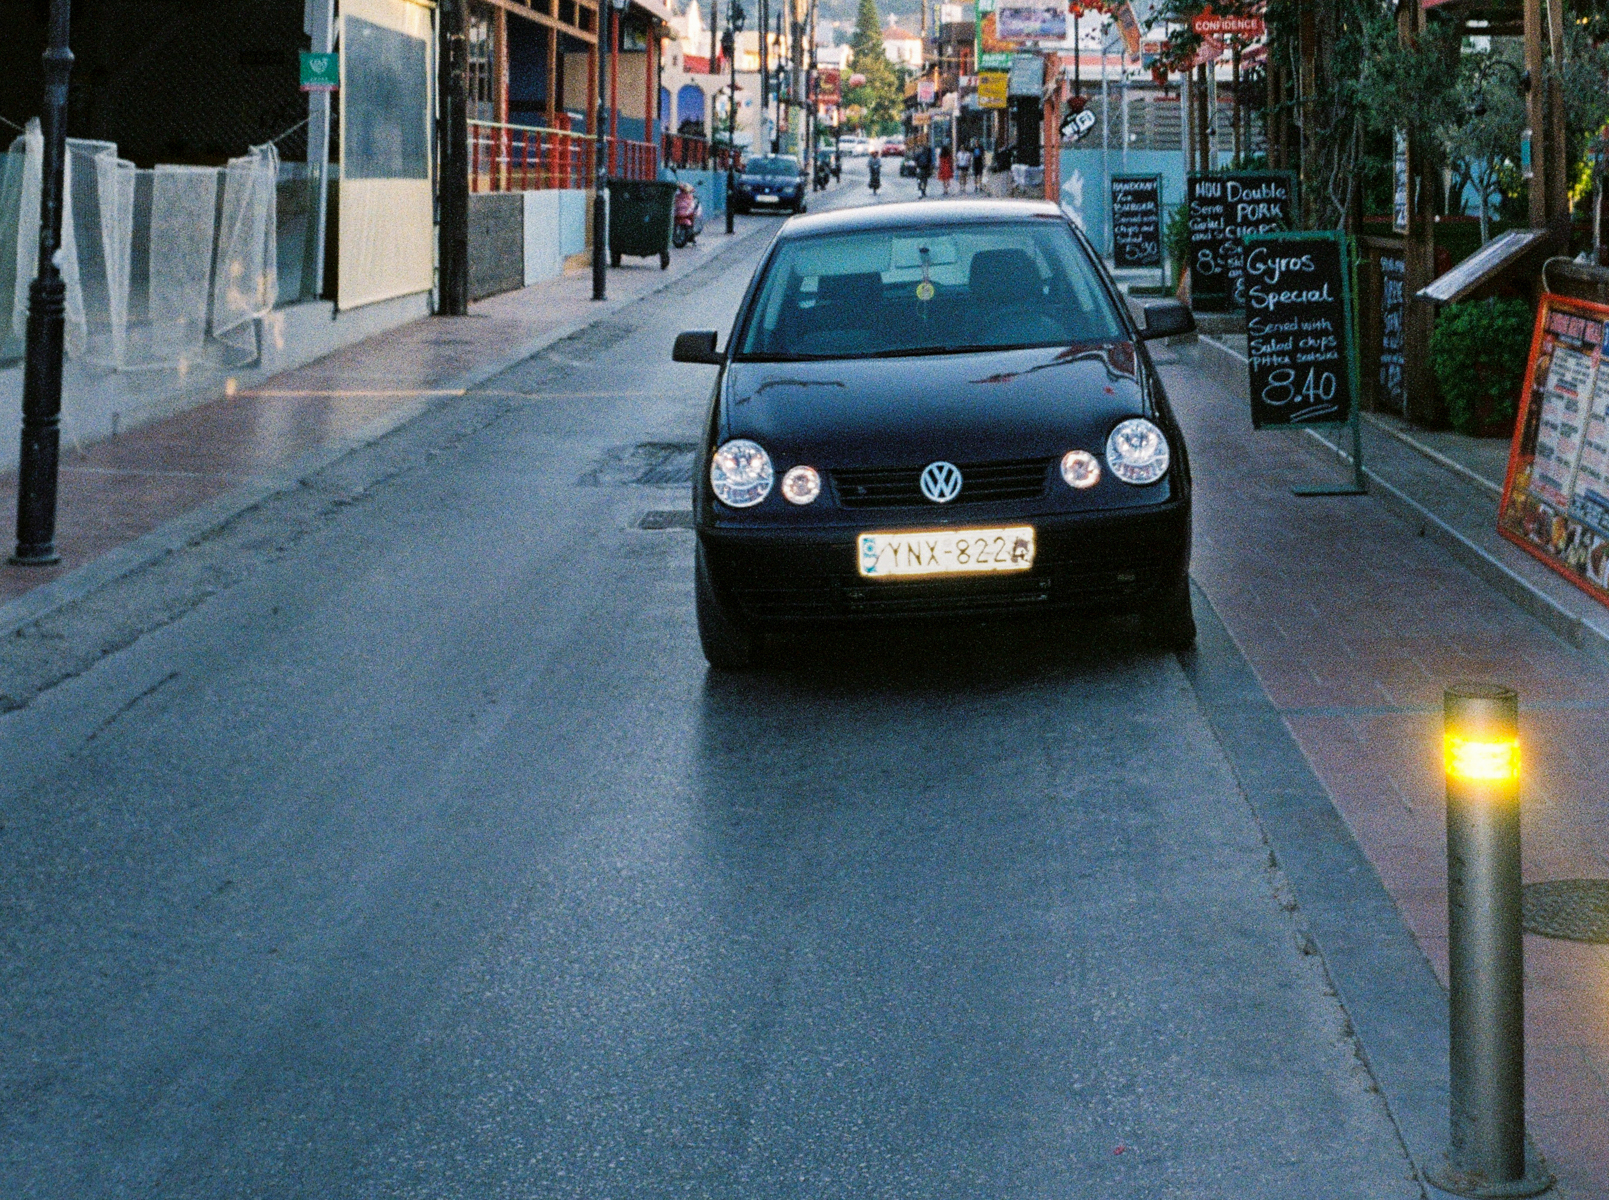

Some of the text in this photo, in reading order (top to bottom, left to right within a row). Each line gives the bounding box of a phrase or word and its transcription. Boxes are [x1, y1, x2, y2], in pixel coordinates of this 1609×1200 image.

[1195, 18, 1258, 31] CONFIDENCE
[1226, 181, 1287, 202] Double
[1237, 202, 1283, 222] PORK
[1247, 247, 1315, 284] Gyros
[1249, 282, 1334, 311] Special
[1262, 367, 1336, 406] 8.40
